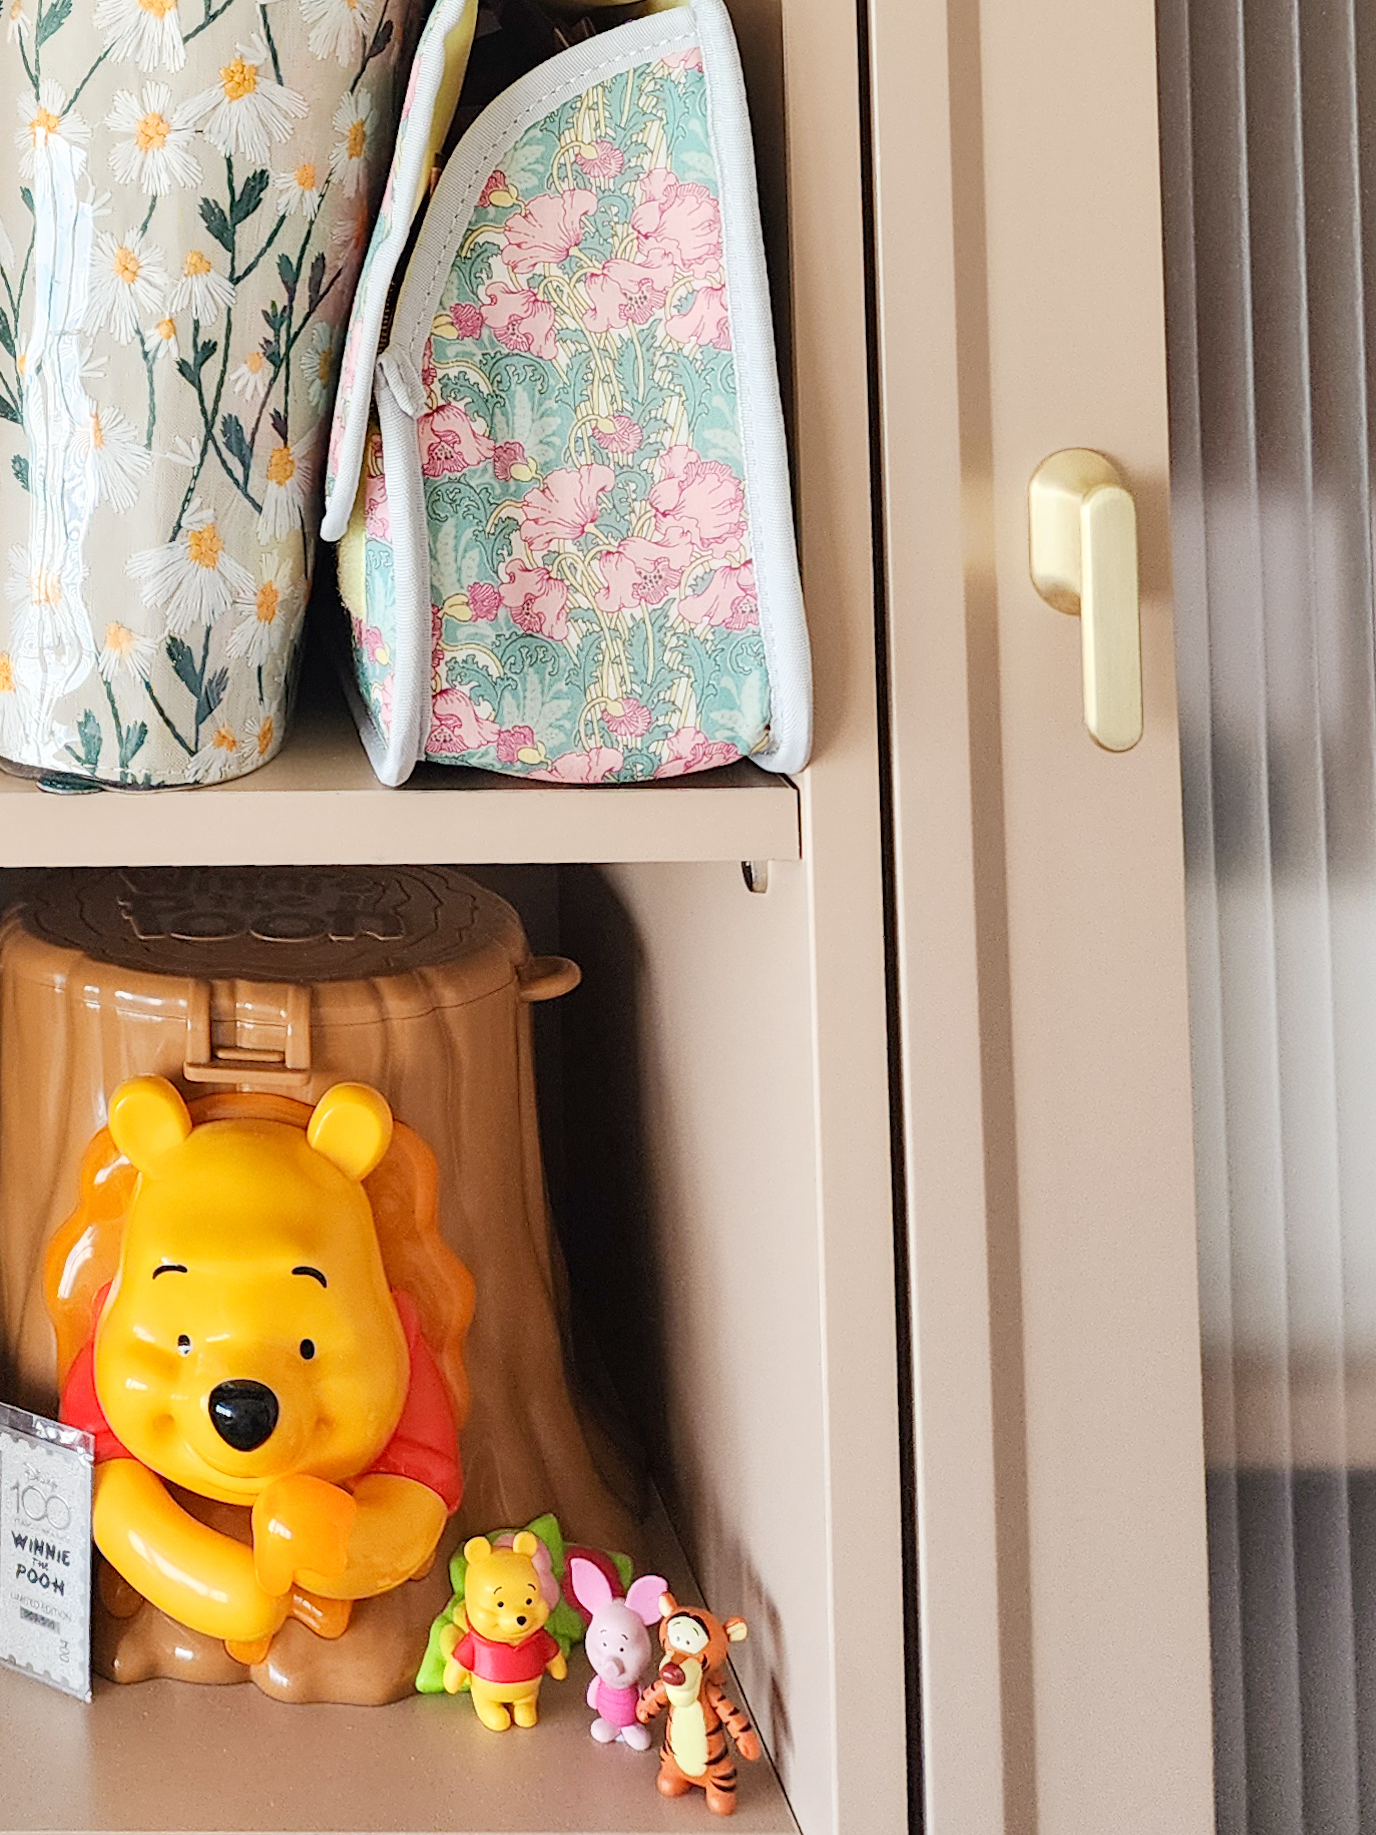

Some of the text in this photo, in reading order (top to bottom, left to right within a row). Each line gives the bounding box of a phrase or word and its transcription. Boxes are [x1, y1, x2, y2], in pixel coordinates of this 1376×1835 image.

[10, 1479, 71, 1530] 100
[11, 1531, 71, 1566] WINNIE
[15, 1565, 66, 1597] POOH
